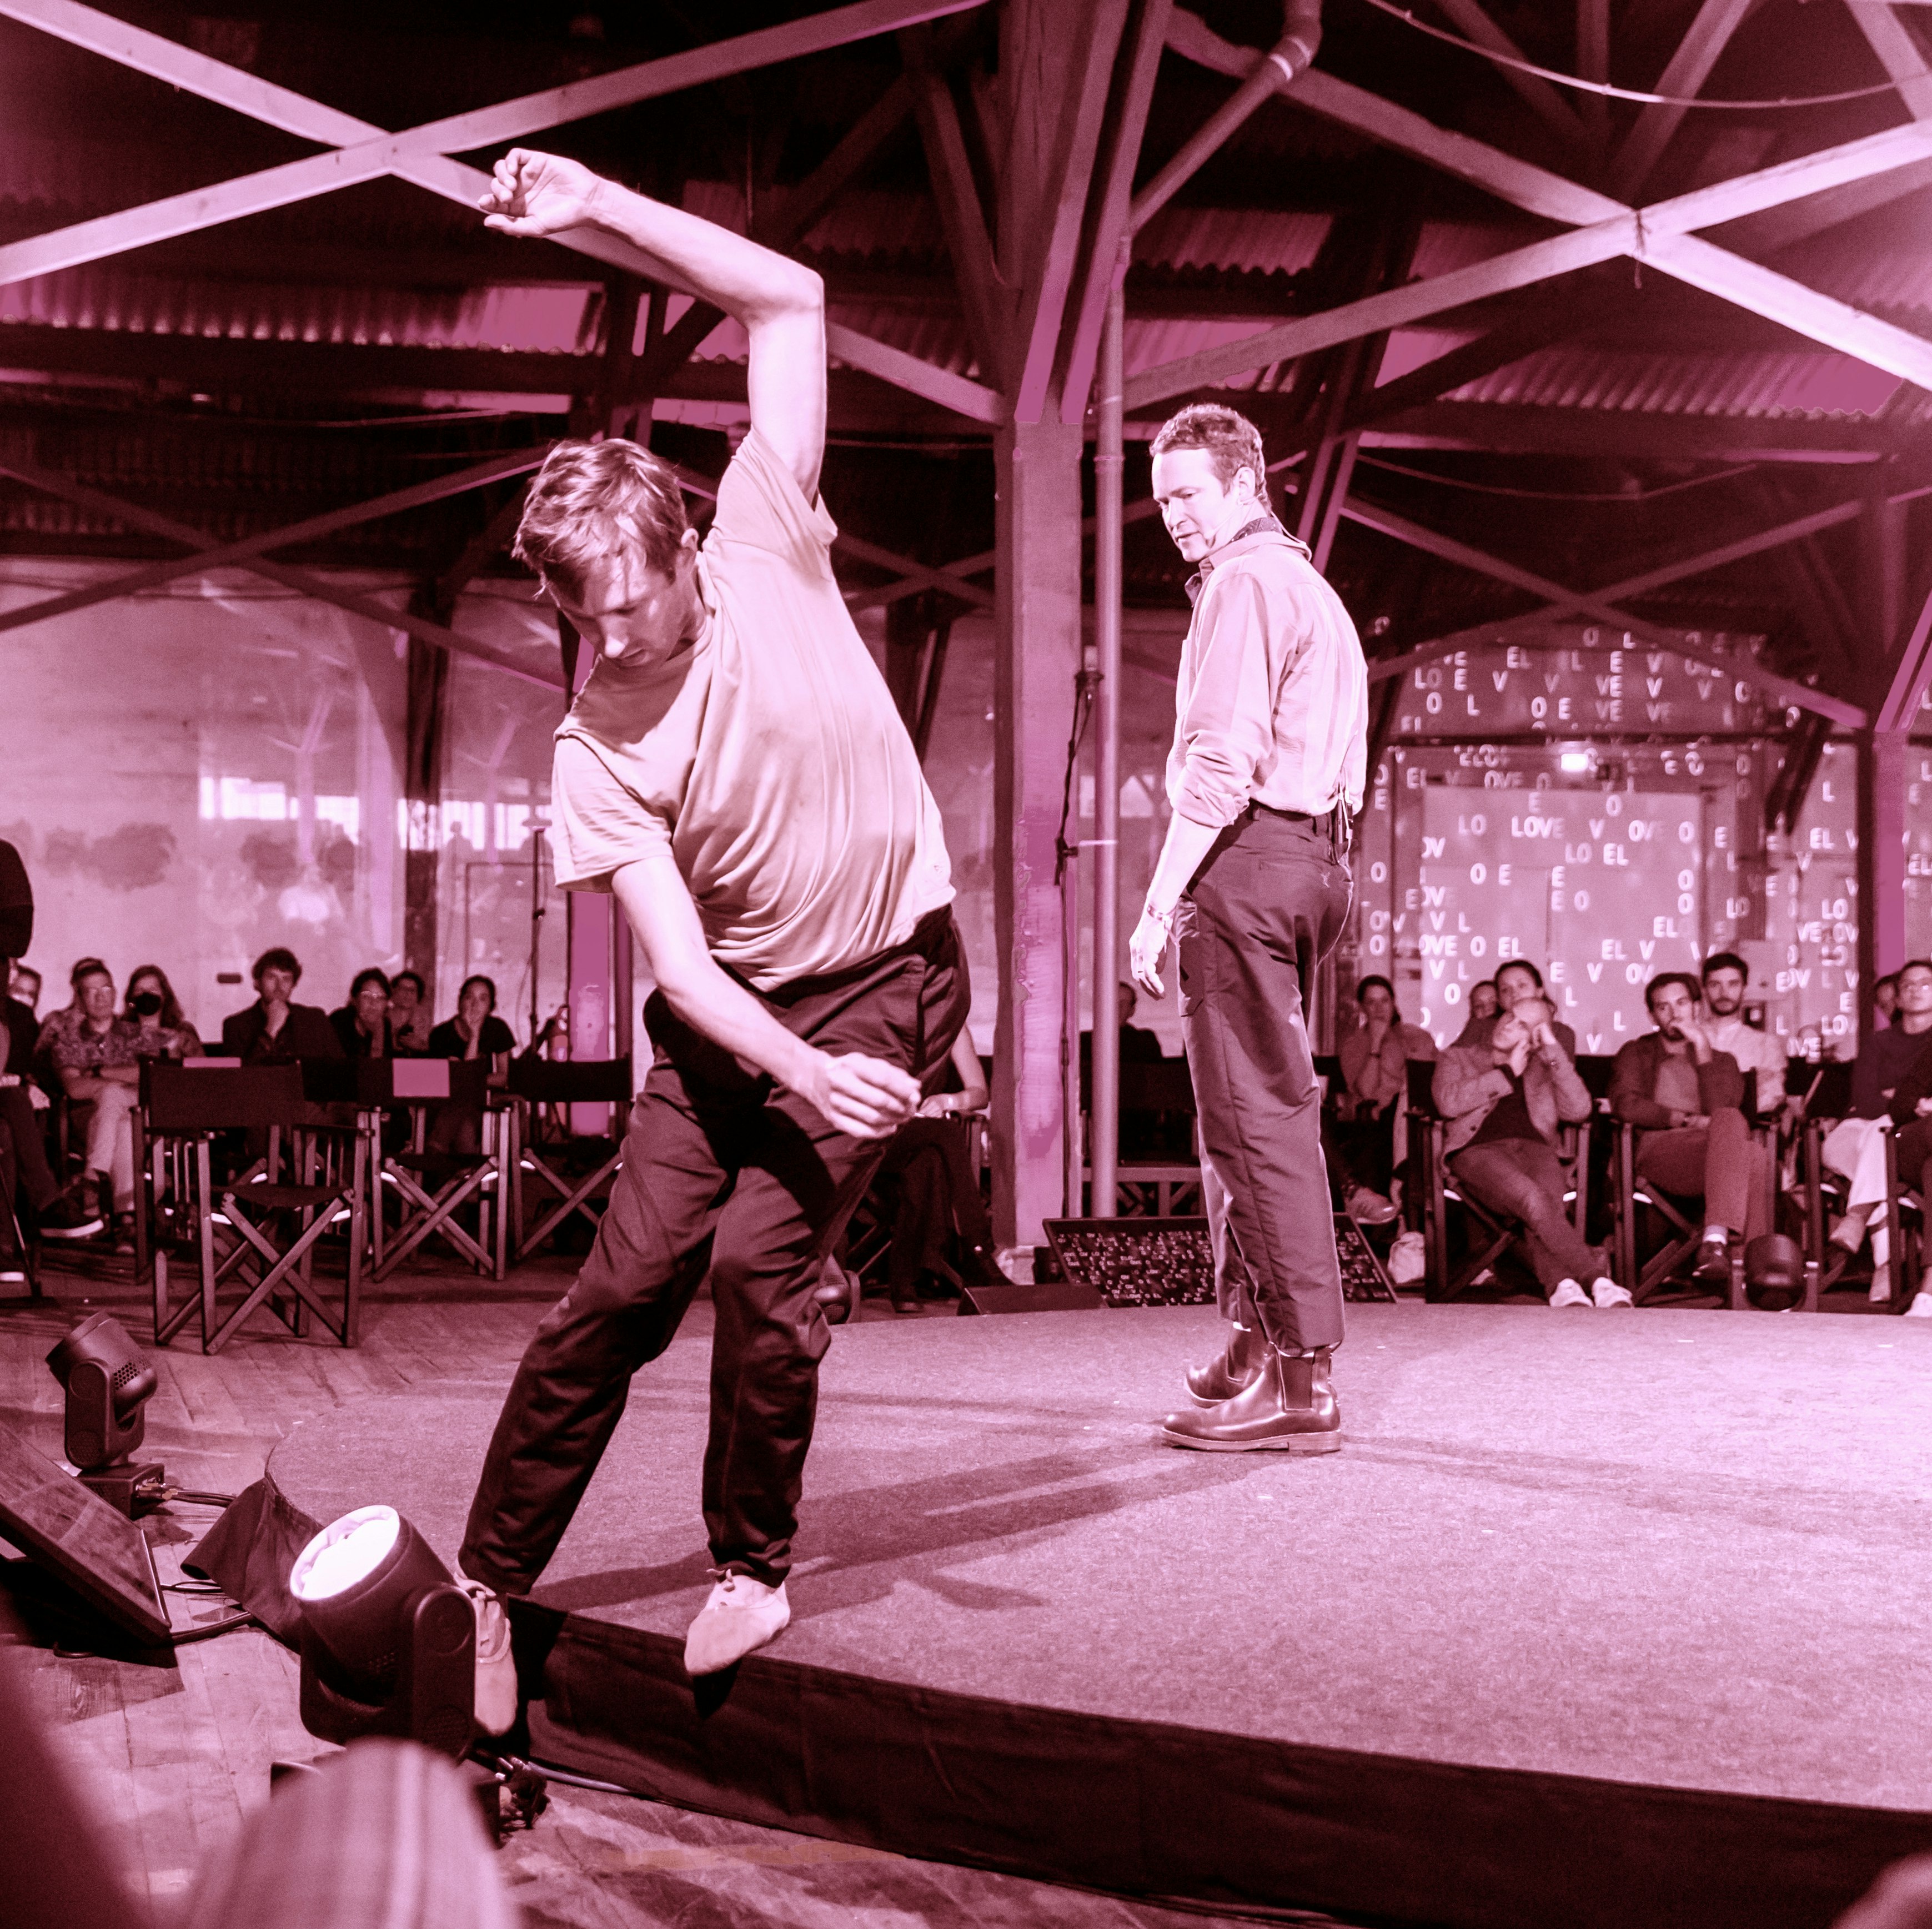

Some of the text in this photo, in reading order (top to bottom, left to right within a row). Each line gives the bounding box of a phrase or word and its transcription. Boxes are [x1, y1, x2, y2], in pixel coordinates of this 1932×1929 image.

[1609, 650, 1624, 674] E
[1454, 667, 1468, 691] E
[1492, 670, 1508, 693] V
[1646, 677, 1663, 699] V
[1426, 692, 1443, 715] O
[1467, 694, 1481, 717] L
[1531, 696, 1548, 719] O
[1558, 697, 1572, 721] E
[1374, 786, 1388, 811] E
[1605, 795, 1622, 817] O
[1822, 780, 1835, 803] L
[1511, 816, 1564, 838] LOVE
[1589, 819, 1605, 840] V
[1678, 821, 1695, 843] O
[1715, 826, 1728, 849] E
[1809, 826, 1835, 850] EL
[1565, 843, 1592, 864] LO
[1603, 842, 1629, 866] EL
[1370, 861, 1387, 883] O
[1469, 862, 1487, 885] O
[1498, 863, 1512, 887] E
[1552, 865, 1565, 888] E
[1677, 869, 1694, 892] O
[1765, 876, 1778, 898] E
[1574, 890, 1590, 912] O
[1677, 892, 1694, 915] O
[1821, 898, 1848, 920] LO
[1429, 911, 1446, 932] V
[1458, 911, 1471, 933] L
[1653, 916, 1678, 938] EL
[1798, 921, 1821, 943] VE
[1369, 934, 1387, 956] O
[1469, 935, 1487, 957] O
[1497, 936, 1524, 959] EL
[1602, 938, 1628, 961] EL
[1639, 940, 1655, 961] V
[1429, 960, 1445, 981] V
[1458, 961, 1471, 981] L
[1550, 961, 1565, 984] E
[1587, 963, 1603, 984] V
[1444, 983, 1852, 1013] O L E
[1613, 1011, 1627, 1032] L
[1777, 1015, 1789, 1036] L
[1587, 1033, 1603, 1056] V
